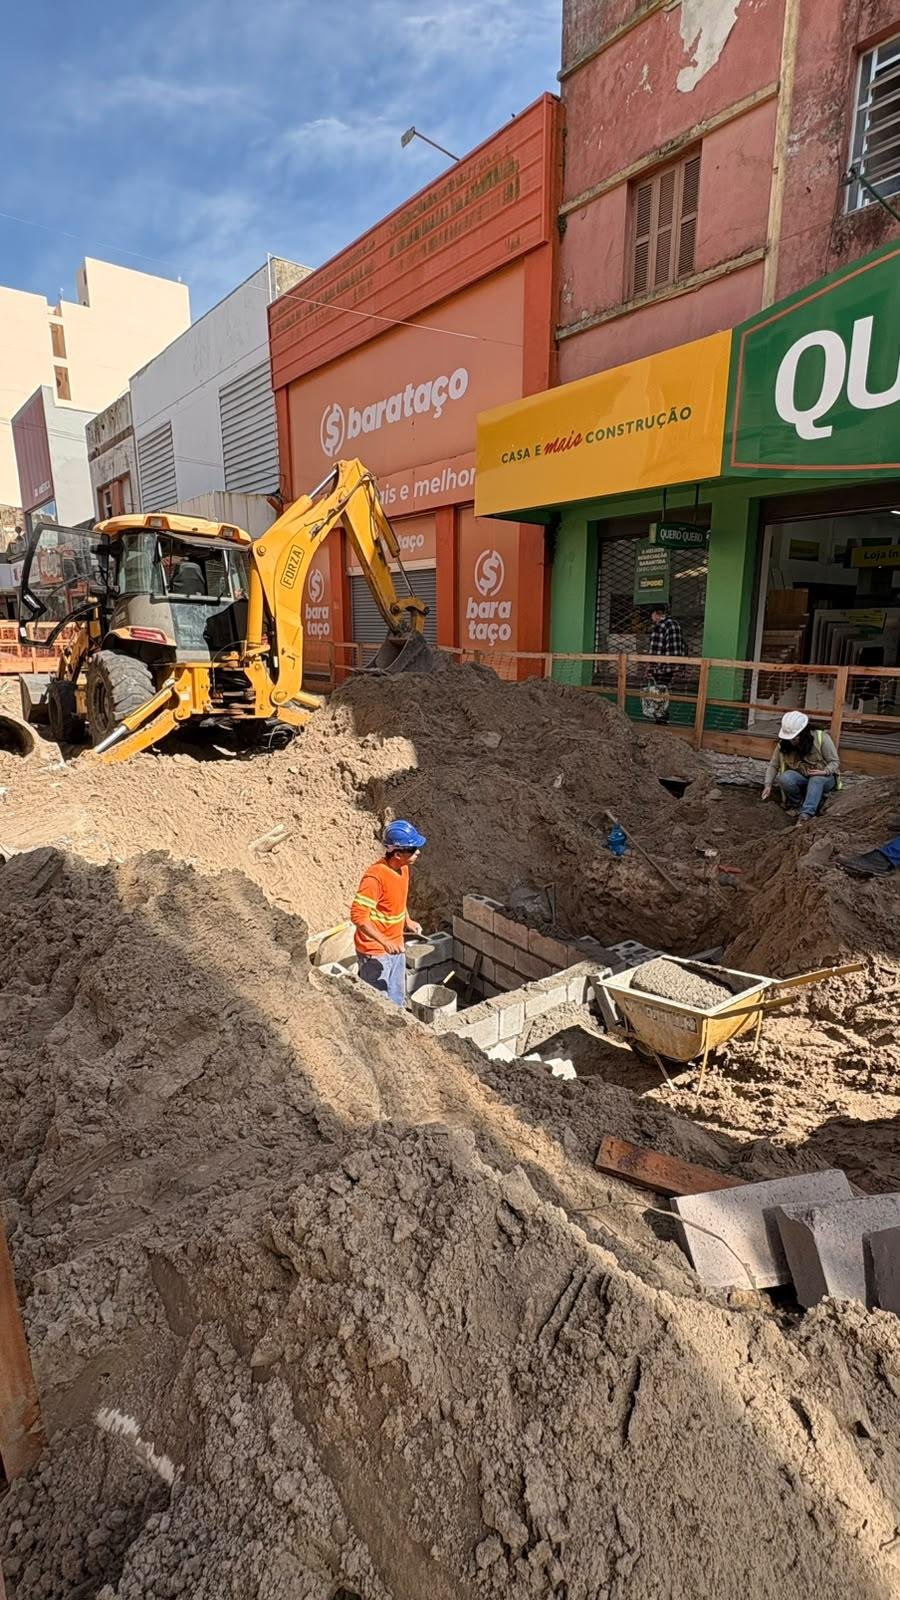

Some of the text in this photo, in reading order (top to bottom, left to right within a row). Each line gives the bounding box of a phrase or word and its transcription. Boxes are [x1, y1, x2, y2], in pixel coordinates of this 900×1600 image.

[347, 367, 469, 439] barataço
[501, 406, 692, 464] CASA E mais CONSTRUÇÃO
[400, 484, 409, 501] e
[283, 548, 302, 586] FORZA
[305, 603, 329, 619] bara
[466, 599, 511, 619] bara
[307, 620, 330, 640] taço
[469, 621, 511, 646] taço
